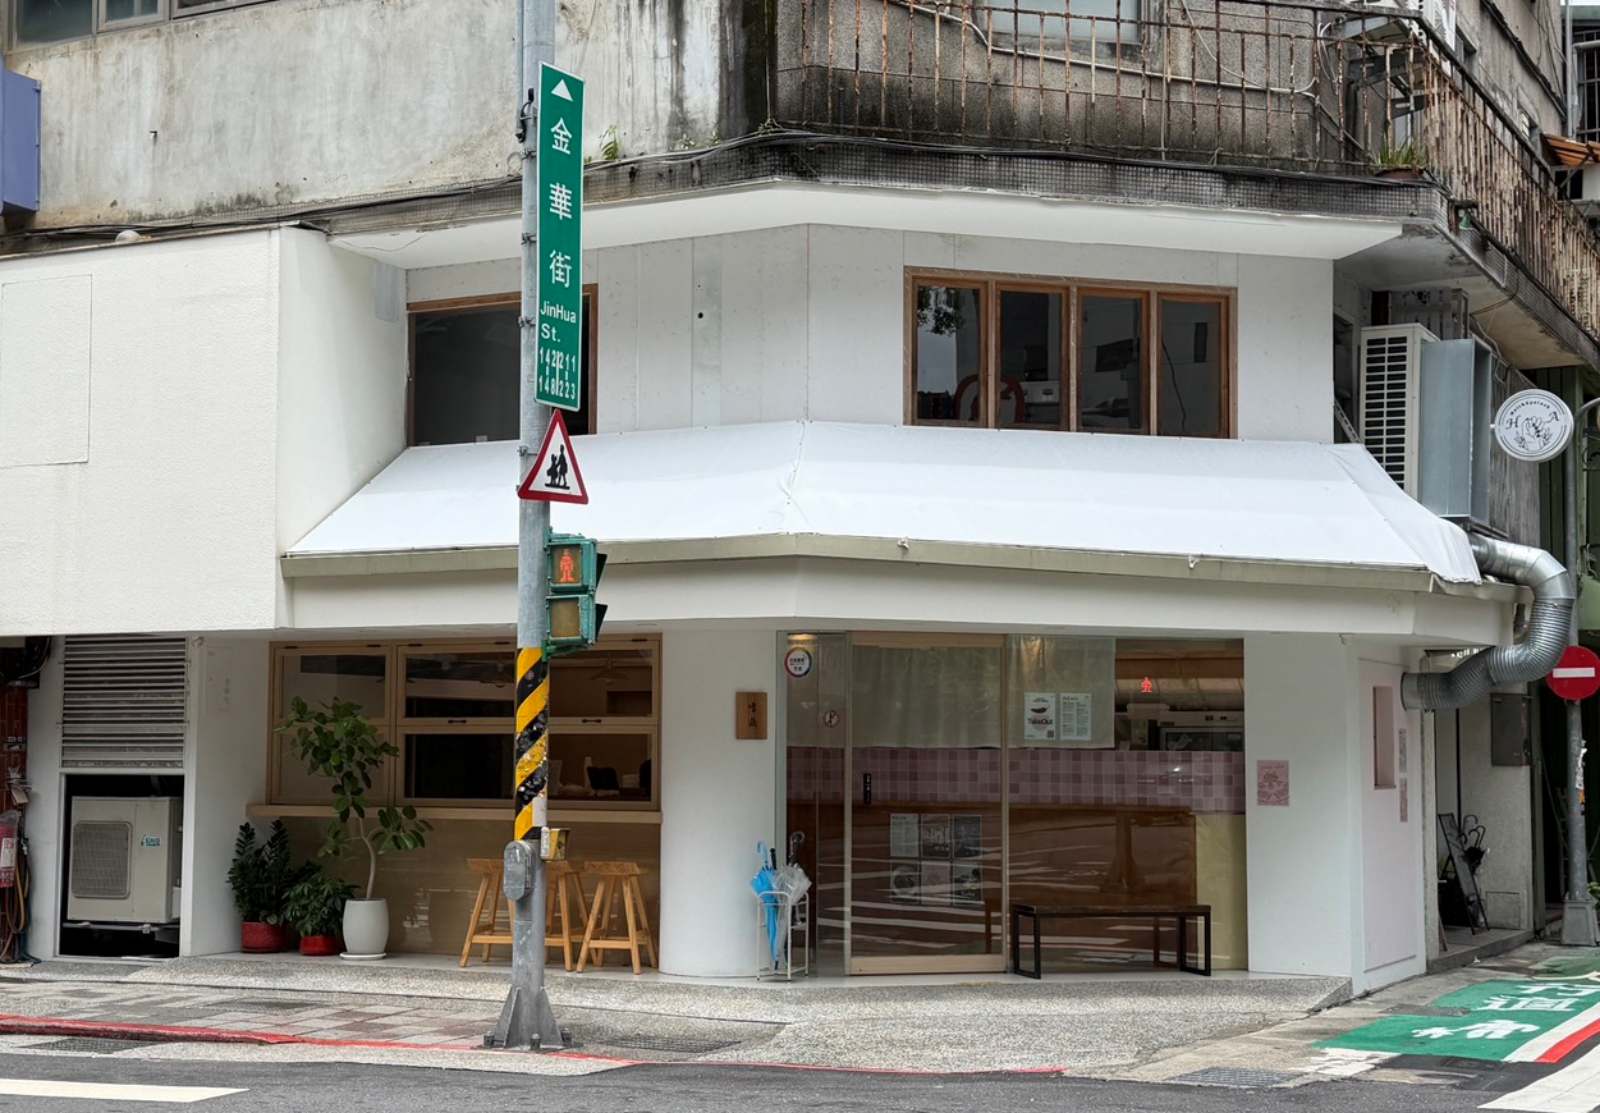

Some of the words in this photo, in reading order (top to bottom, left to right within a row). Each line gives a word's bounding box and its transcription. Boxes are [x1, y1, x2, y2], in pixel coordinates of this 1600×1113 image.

[550, 117, 573, 289] 金華街
[540, 300, 577, 324] JinHua
[541, 323, 561, 342] St.
